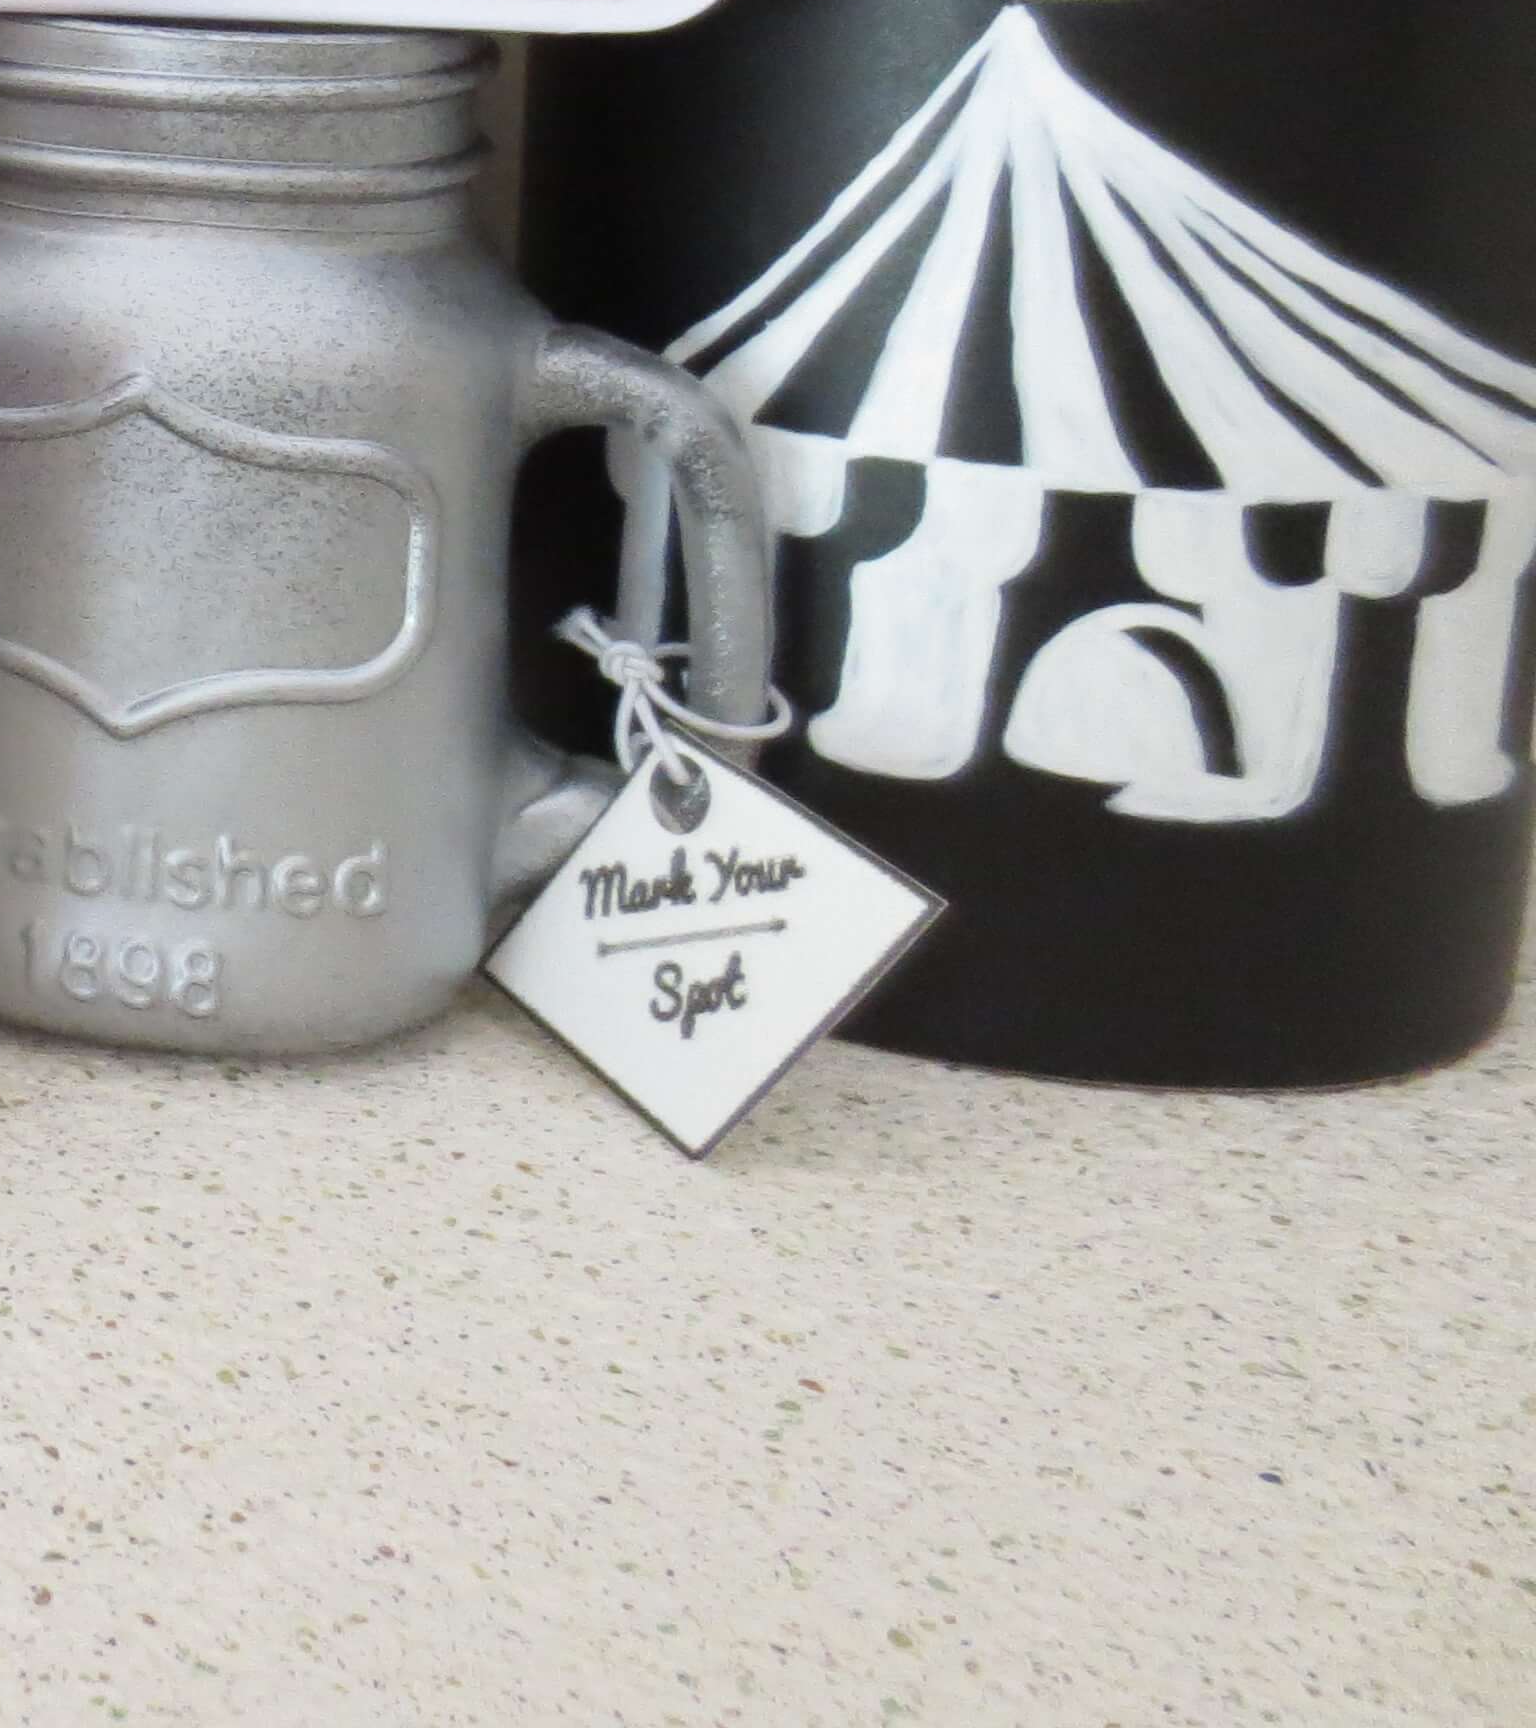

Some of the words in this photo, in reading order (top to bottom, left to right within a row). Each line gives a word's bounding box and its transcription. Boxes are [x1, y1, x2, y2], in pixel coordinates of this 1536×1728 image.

[578, 845, 697, 920] Mark
[704, 843, 807, 903] Your
[20, 920, 225, 1020] 1898
[648, 949, 747, 1040] Spot
